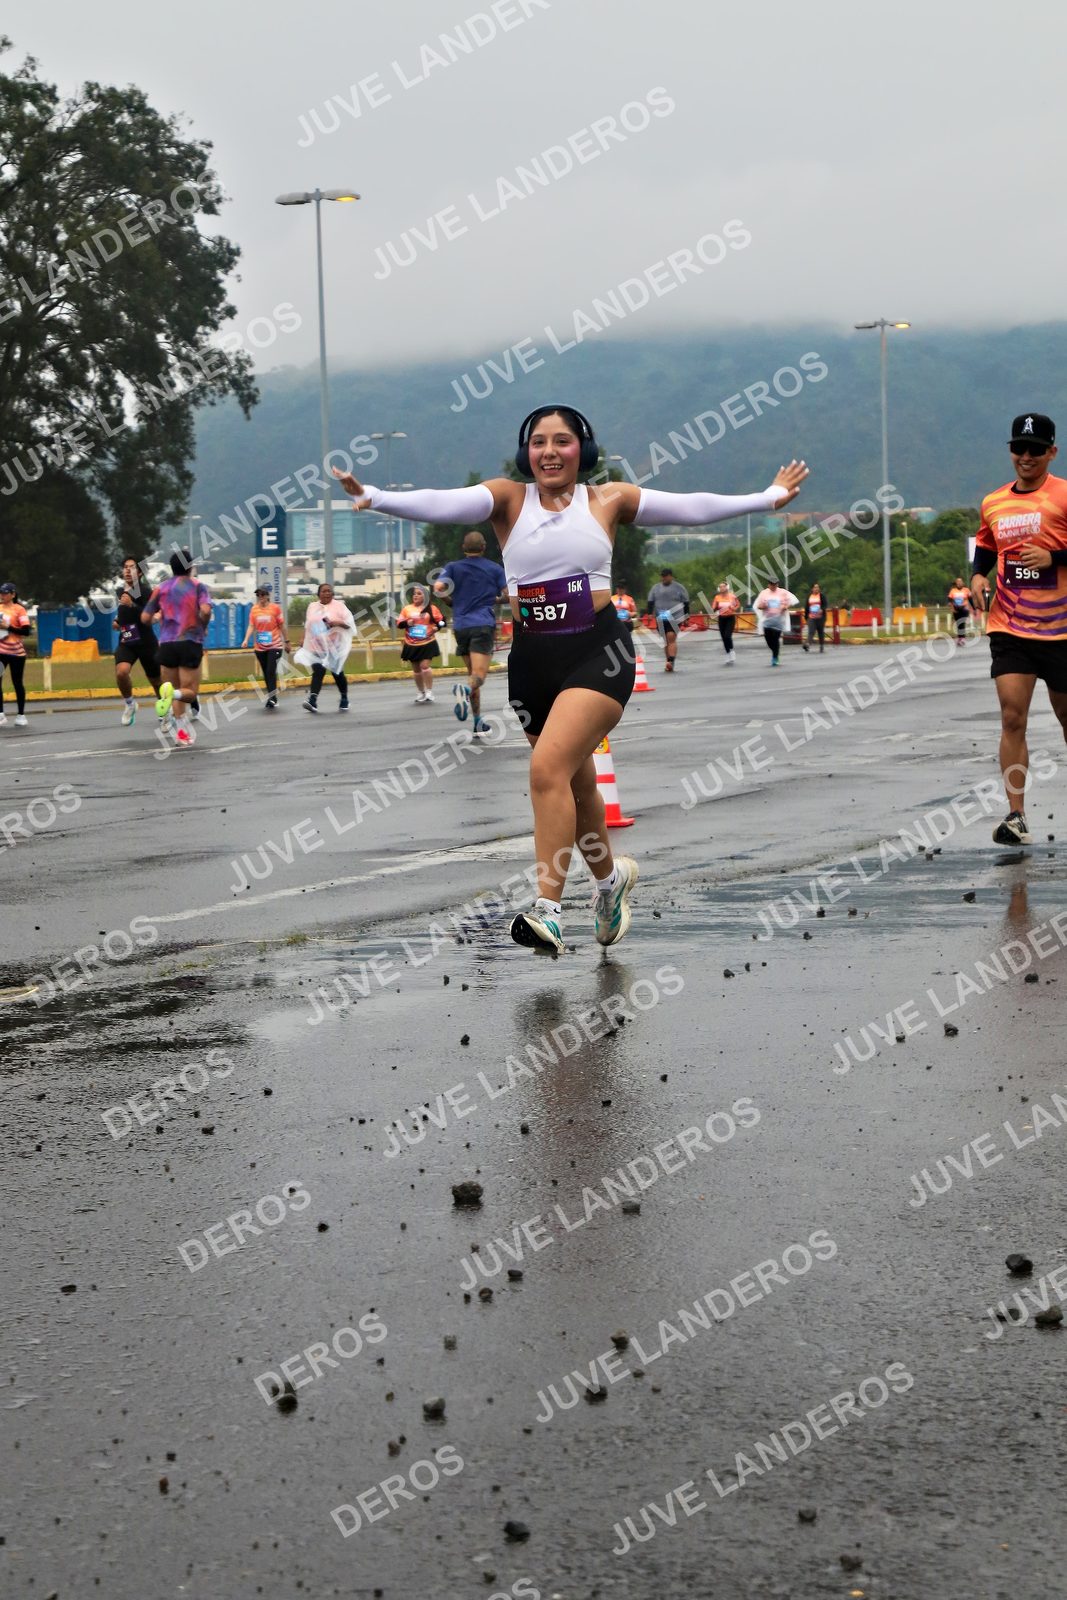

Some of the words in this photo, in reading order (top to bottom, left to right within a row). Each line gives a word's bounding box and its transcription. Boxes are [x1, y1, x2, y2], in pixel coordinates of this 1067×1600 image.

[998, 512, 1041, 530] CARRERA
[262, 527, 278, 549] E
[1015, 567, 1040, 579] 596
[532, 602, 567, 621] 587
